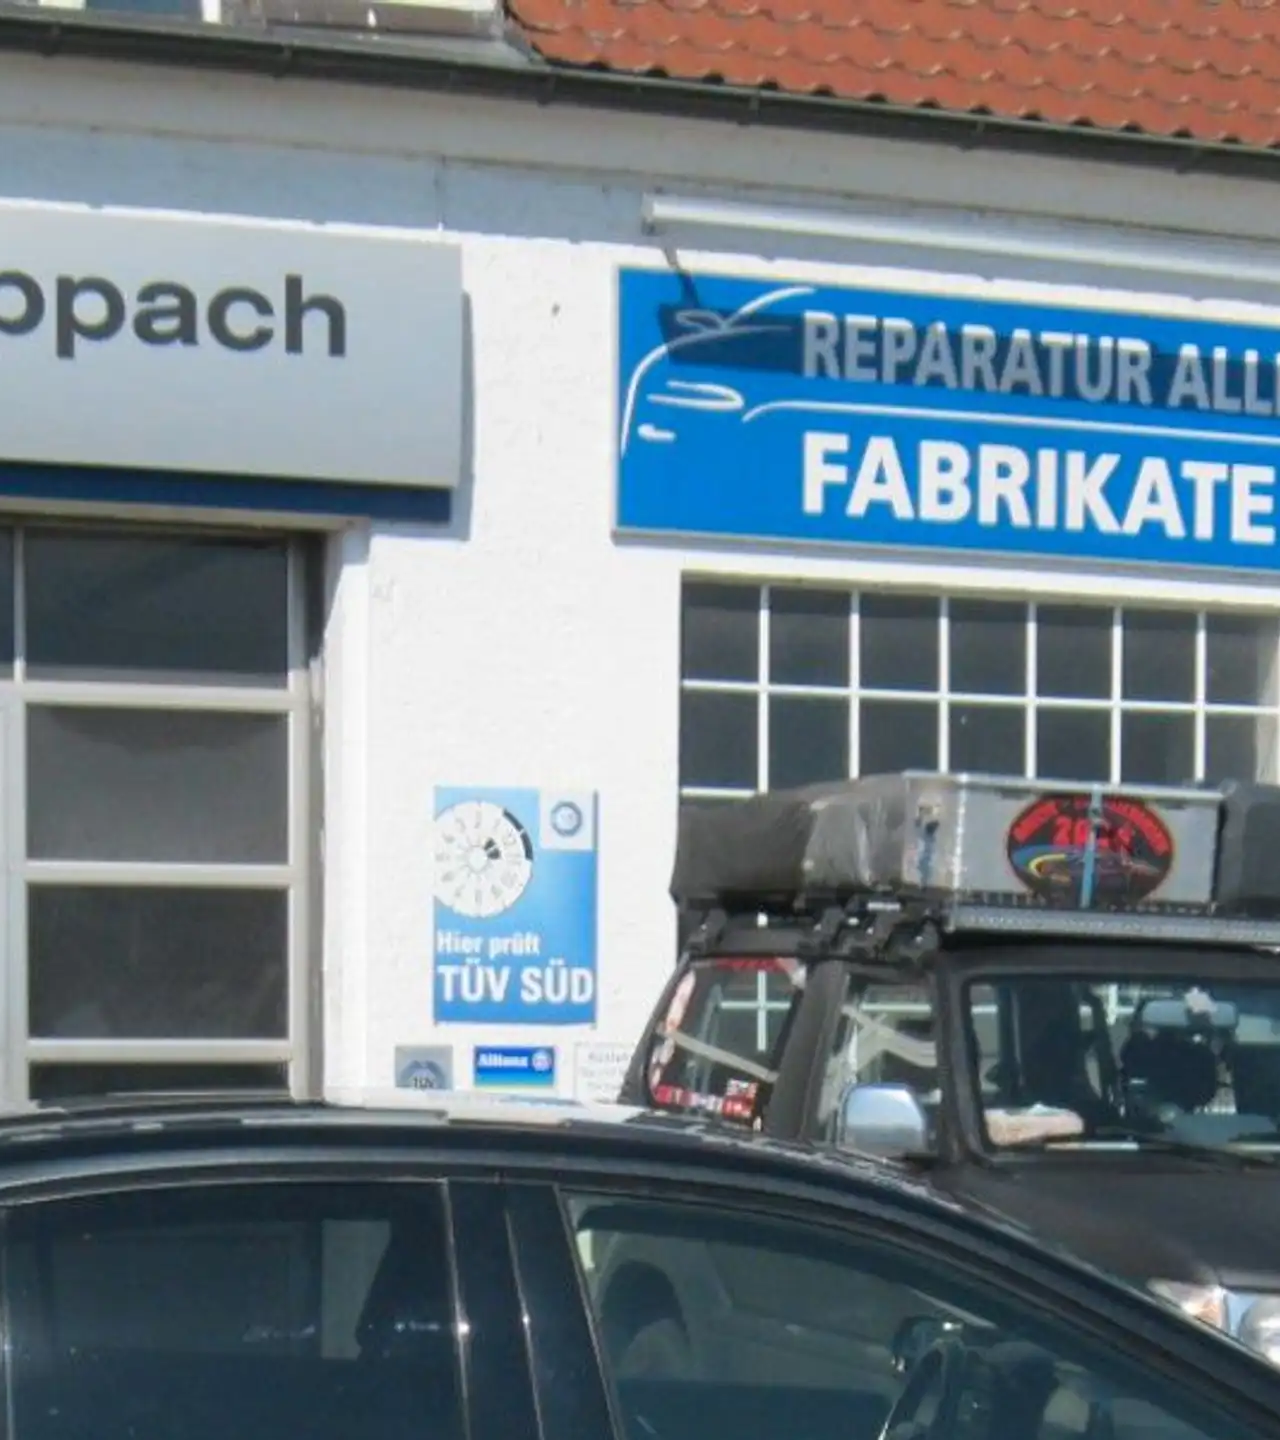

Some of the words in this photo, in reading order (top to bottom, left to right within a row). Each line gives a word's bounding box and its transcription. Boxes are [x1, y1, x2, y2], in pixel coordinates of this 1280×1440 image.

[802, 311, 1153, 405] REPARATUR
[802, 432, 1278, 545] FABRIKATE
[437, 930, 483, 953] Hier
[489, 931, 540, 959] prüft
[437, 957, 511, 1001] TÜV
[520, 957, 593, 1005] SÜD
